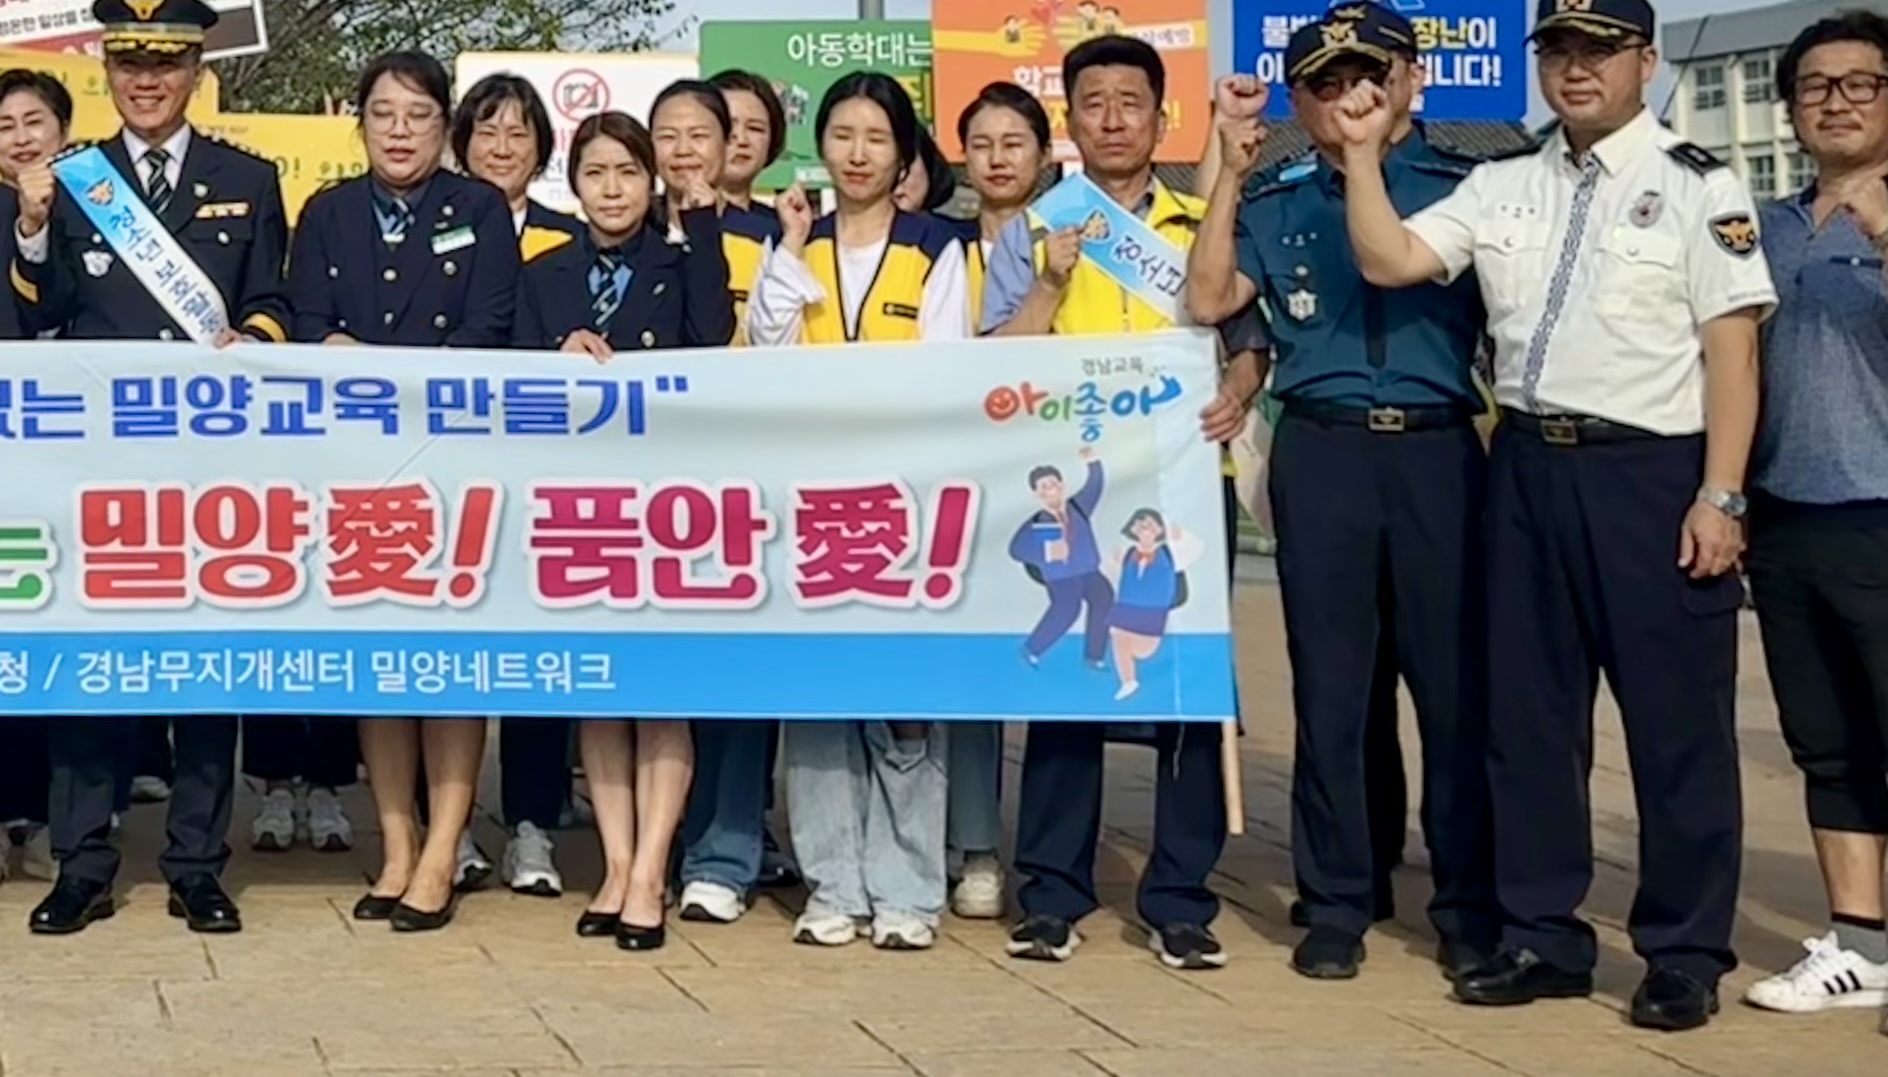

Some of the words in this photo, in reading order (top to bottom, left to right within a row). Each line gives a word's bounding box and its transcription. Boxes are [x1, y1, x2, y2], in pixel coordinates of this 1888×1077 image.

[786, 31, 934, 68] 아동학대는
[108, 204, 165, 263] 청소년
[154, 259, 221, 335] 보호활동
[1079, 356, 1146, 377] 경남교육
[112, 373, 401, 439] 밀양교육
[983, 370, 1185, 444] 아이좋아
[79, 484, 311, 601] 밀양
[529, 484, 769, 600] 품안
[76, 650, 357, 694] 경남무지개센터
[369, 648, 617, 695] 밀양네트워크
